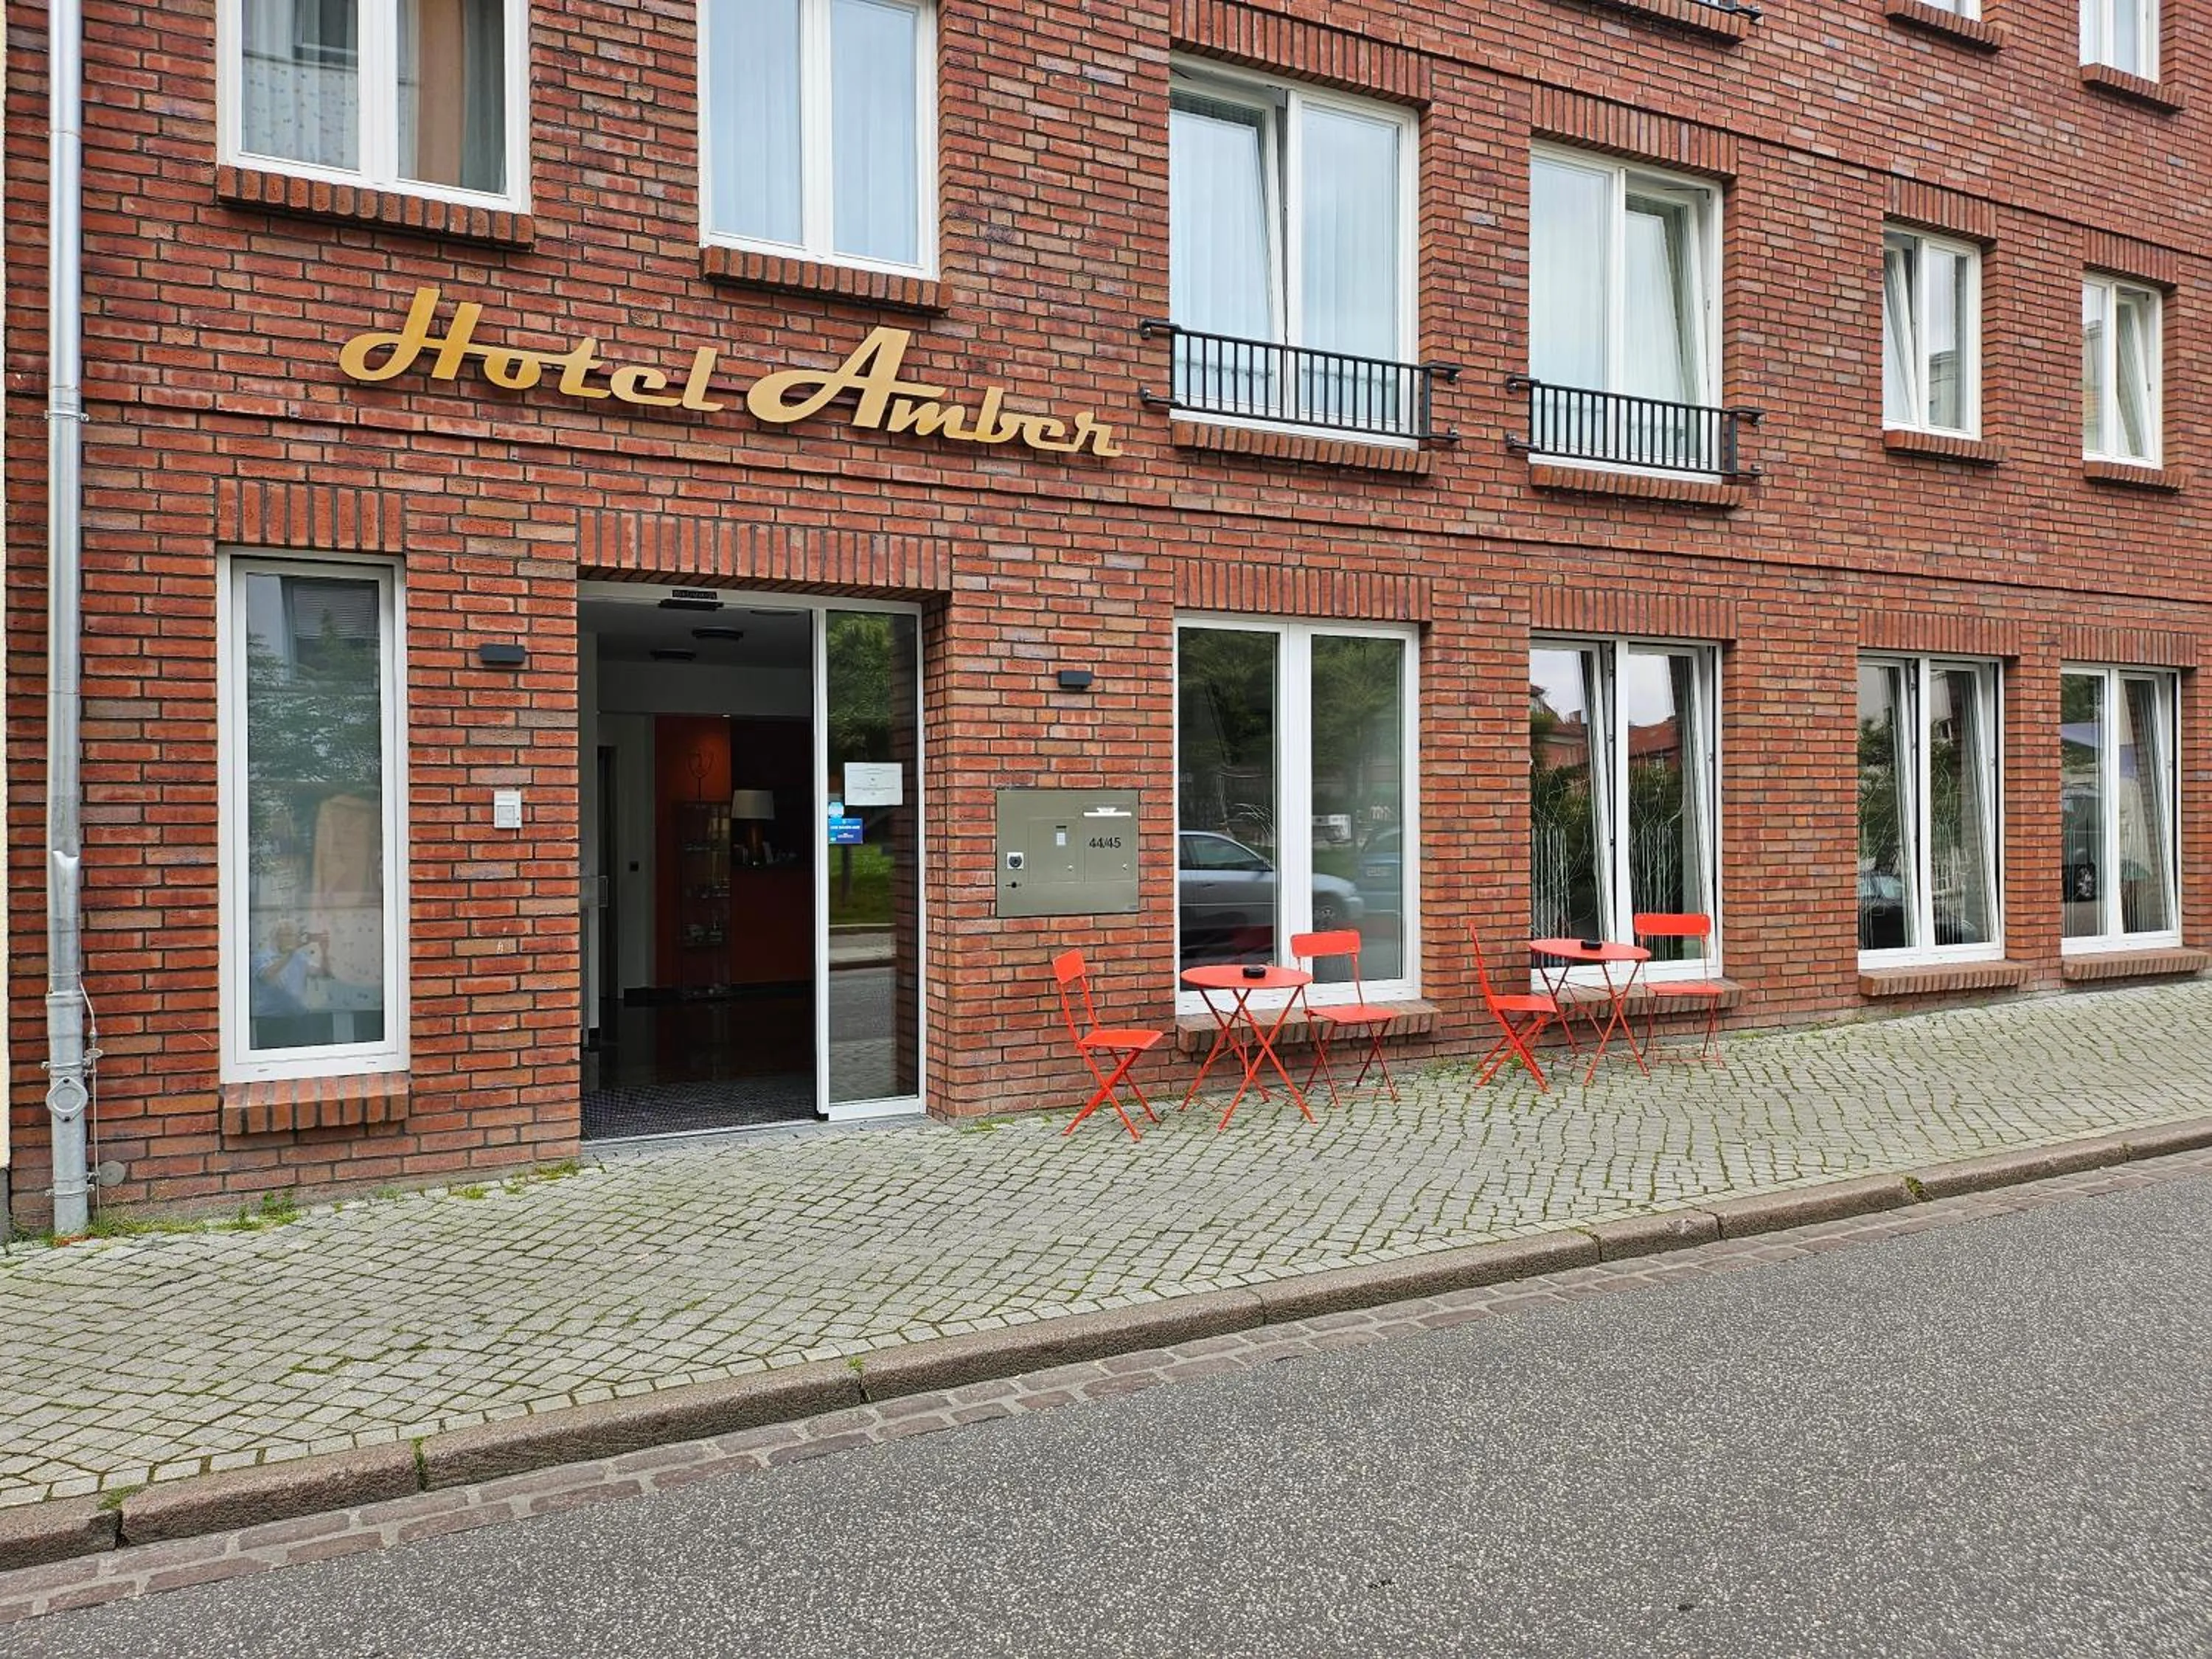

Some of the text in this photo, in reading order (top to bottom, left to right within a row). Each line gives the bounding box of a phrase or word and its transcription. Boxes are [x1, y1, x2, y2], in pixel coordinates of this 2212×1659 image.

[339, 286, 1122, 457] Hotel Amber
[1089, 837, 1121, 849] 44/45
